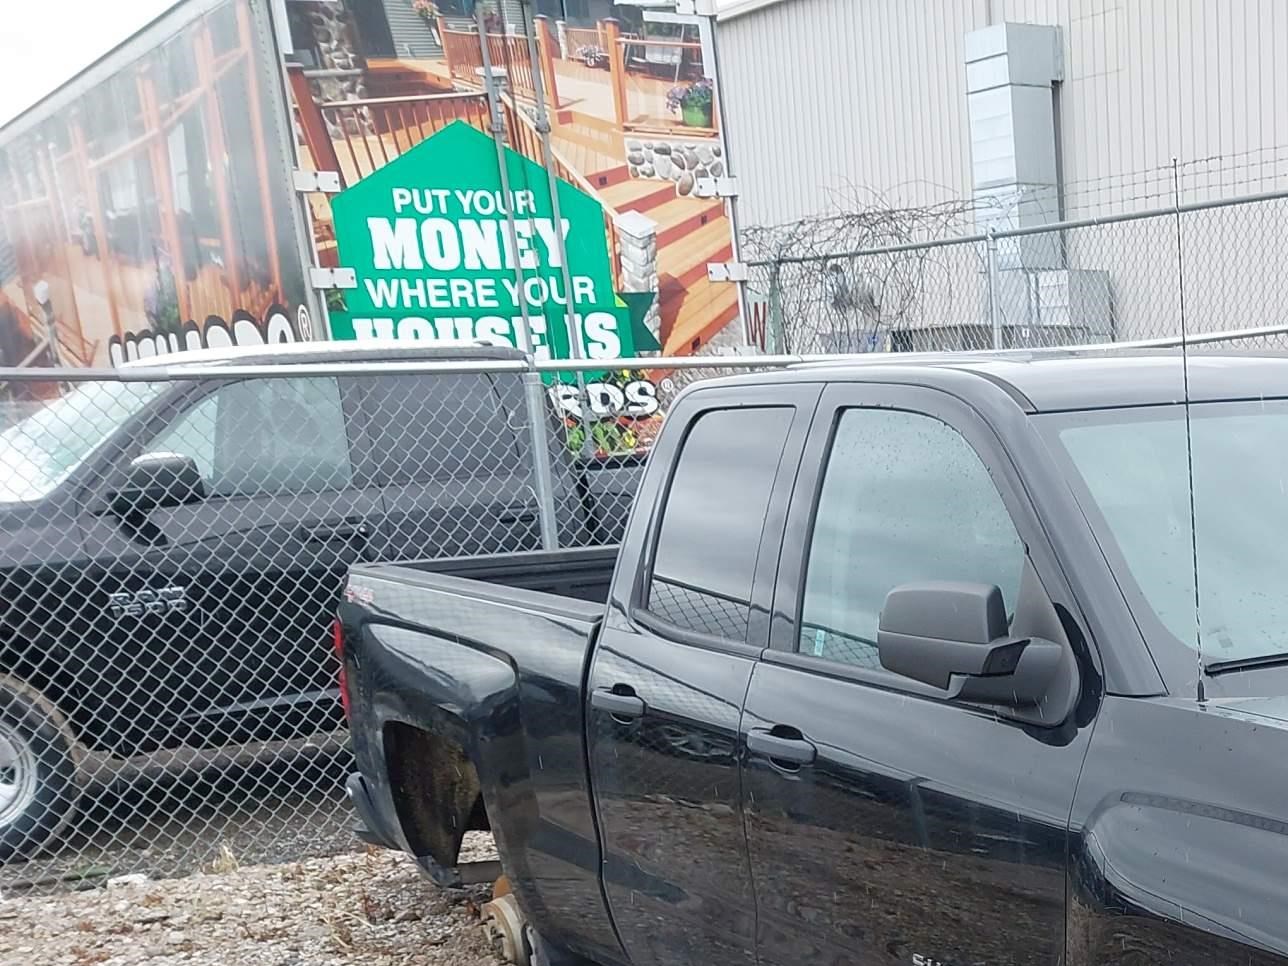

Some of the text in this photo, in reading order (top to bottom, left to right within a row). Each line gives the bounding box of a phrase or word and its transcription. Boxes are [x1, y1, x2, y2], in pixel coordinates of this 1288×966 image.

[392, 187, 537, 216] PUT YOUR
[366, 216, 571, 271] MONEY
[363, 275, 598, 309] WHERE YOUR
[563, 312, 622, 360] IS
